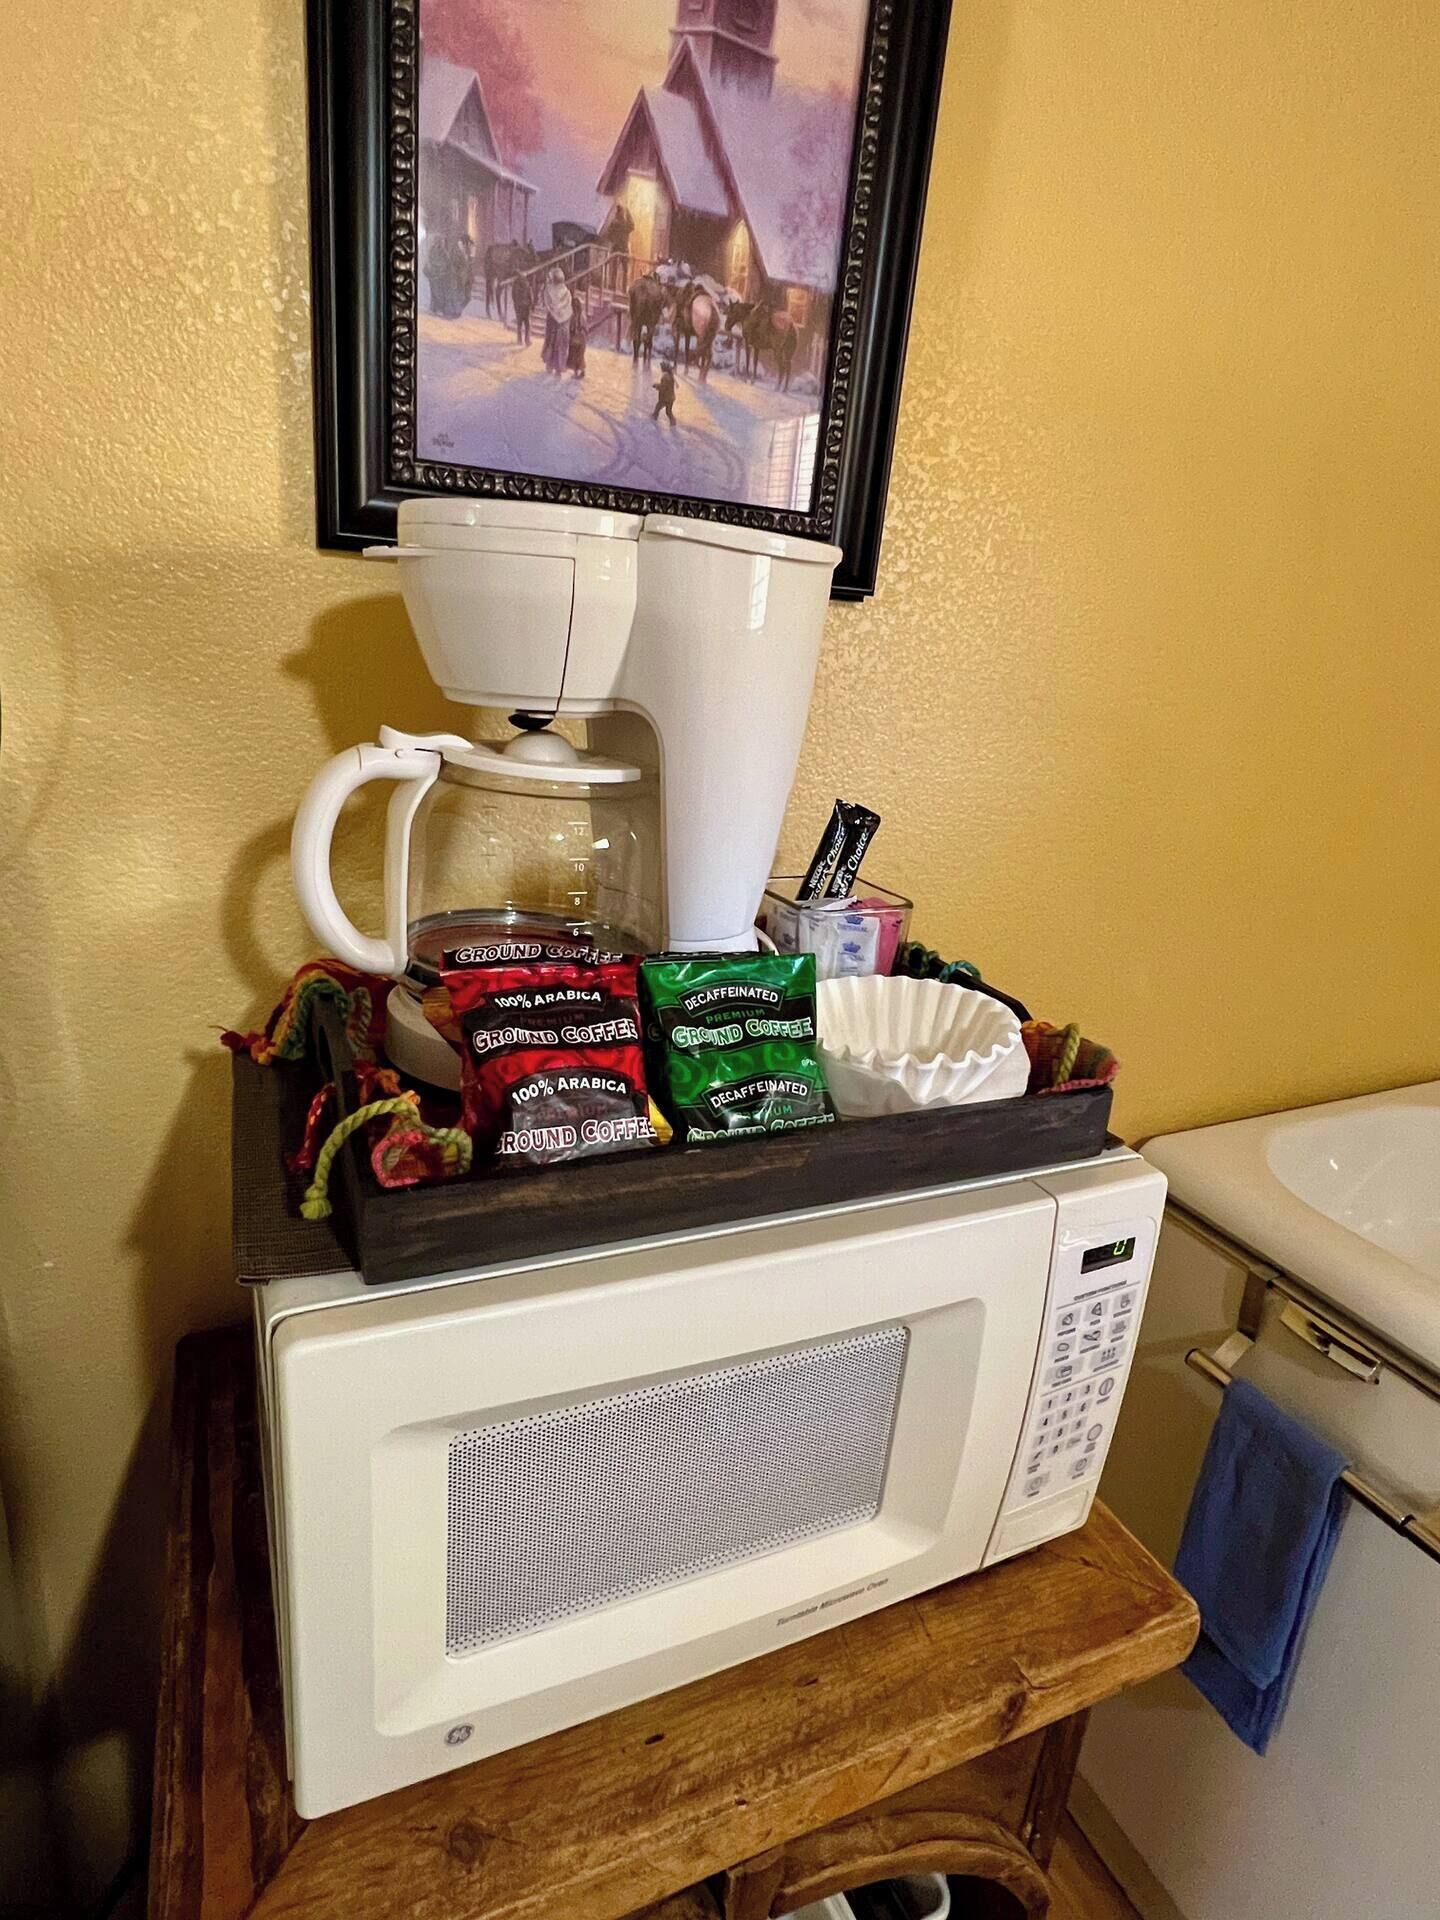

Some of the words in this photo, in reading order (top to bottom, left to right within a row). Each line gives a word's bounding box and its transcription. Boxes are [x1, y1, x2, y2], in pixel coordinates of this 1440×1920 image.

[574, 827, 584, 836] 12
[847, 831, 868, 871] Choice
[575, 863, 585, 872] 10
[574, 897, 581, 906] 8
[573, 928, 579, 937] 6
[455, 943, 541, 964] GROUND
[494, 993, 532, 1009] 100%
[534, 990, 602, 1006] ARABICA
[684, 986, 779, 1011] DECAFFEINATED
[705, 1008, 766, 1025] PREMIUM
[472, 1028, 559, 1054] GROUND
[560, 1018, 639, 1044] COFFEE
[745, 1017, 814, 1039] COFFEE
[512, 1078, 554, 1105] 100%
[557, 1077, 627, 1095] ARABICA
[710, 1079, 808, 1109] DECAFFEINATED
[496, 1125, 577, 1155] ROUND
